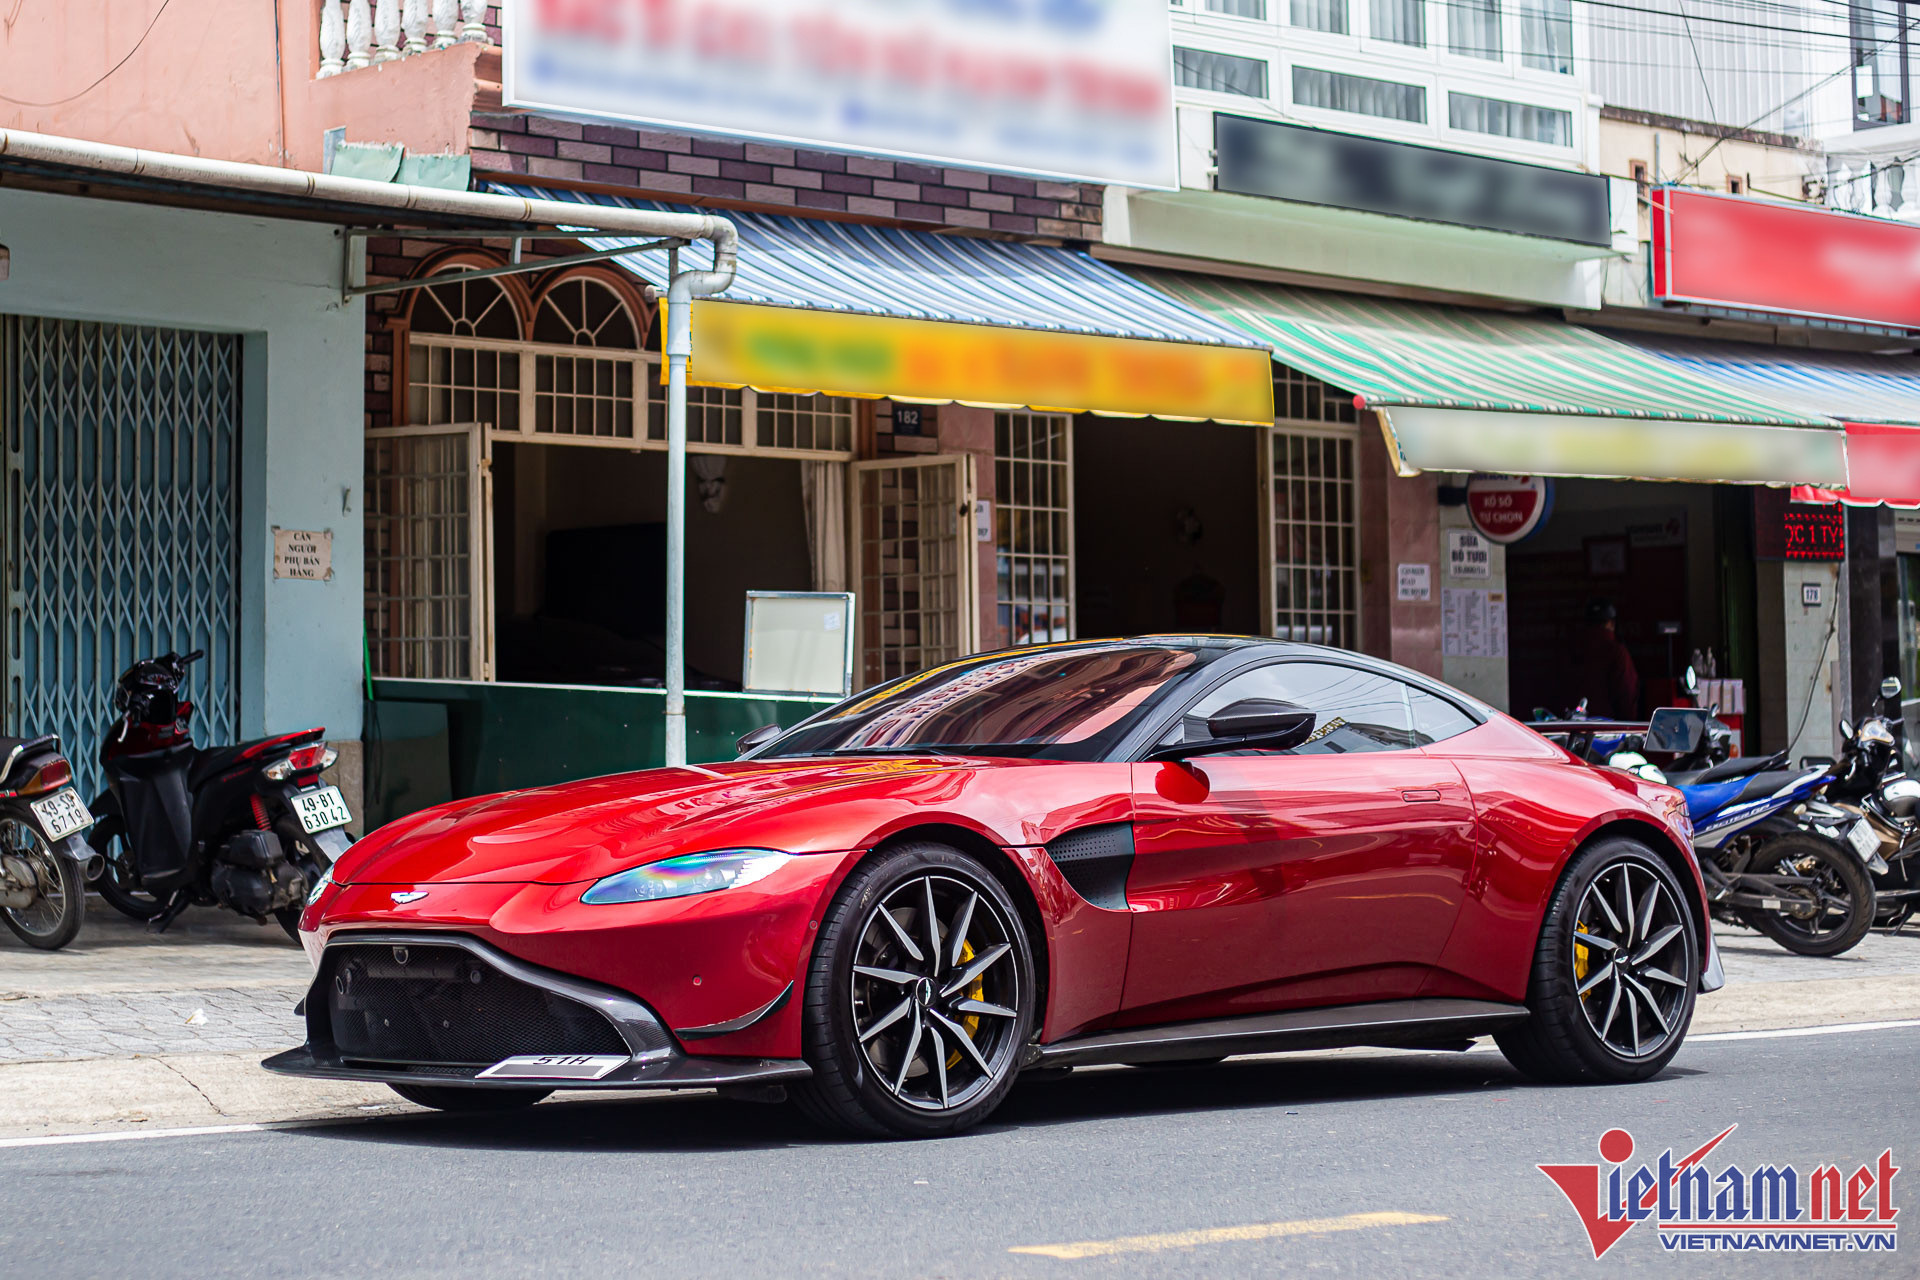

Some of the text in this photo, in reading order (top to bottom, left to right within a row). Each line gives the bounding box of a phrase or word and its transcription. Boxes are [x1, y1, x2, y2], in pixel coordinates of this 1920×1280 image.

[897, 411, 918, 424] 182
[1808, 524, 1816, 544] 1
[1806, 589, 1818, 601] 178
[302, 792, 335, 812] 49-B1
[51, 809, 84, 833] 6719
[304, 806, 347, 829] 630.42
[533, 1056, 594, 1065] 51H
